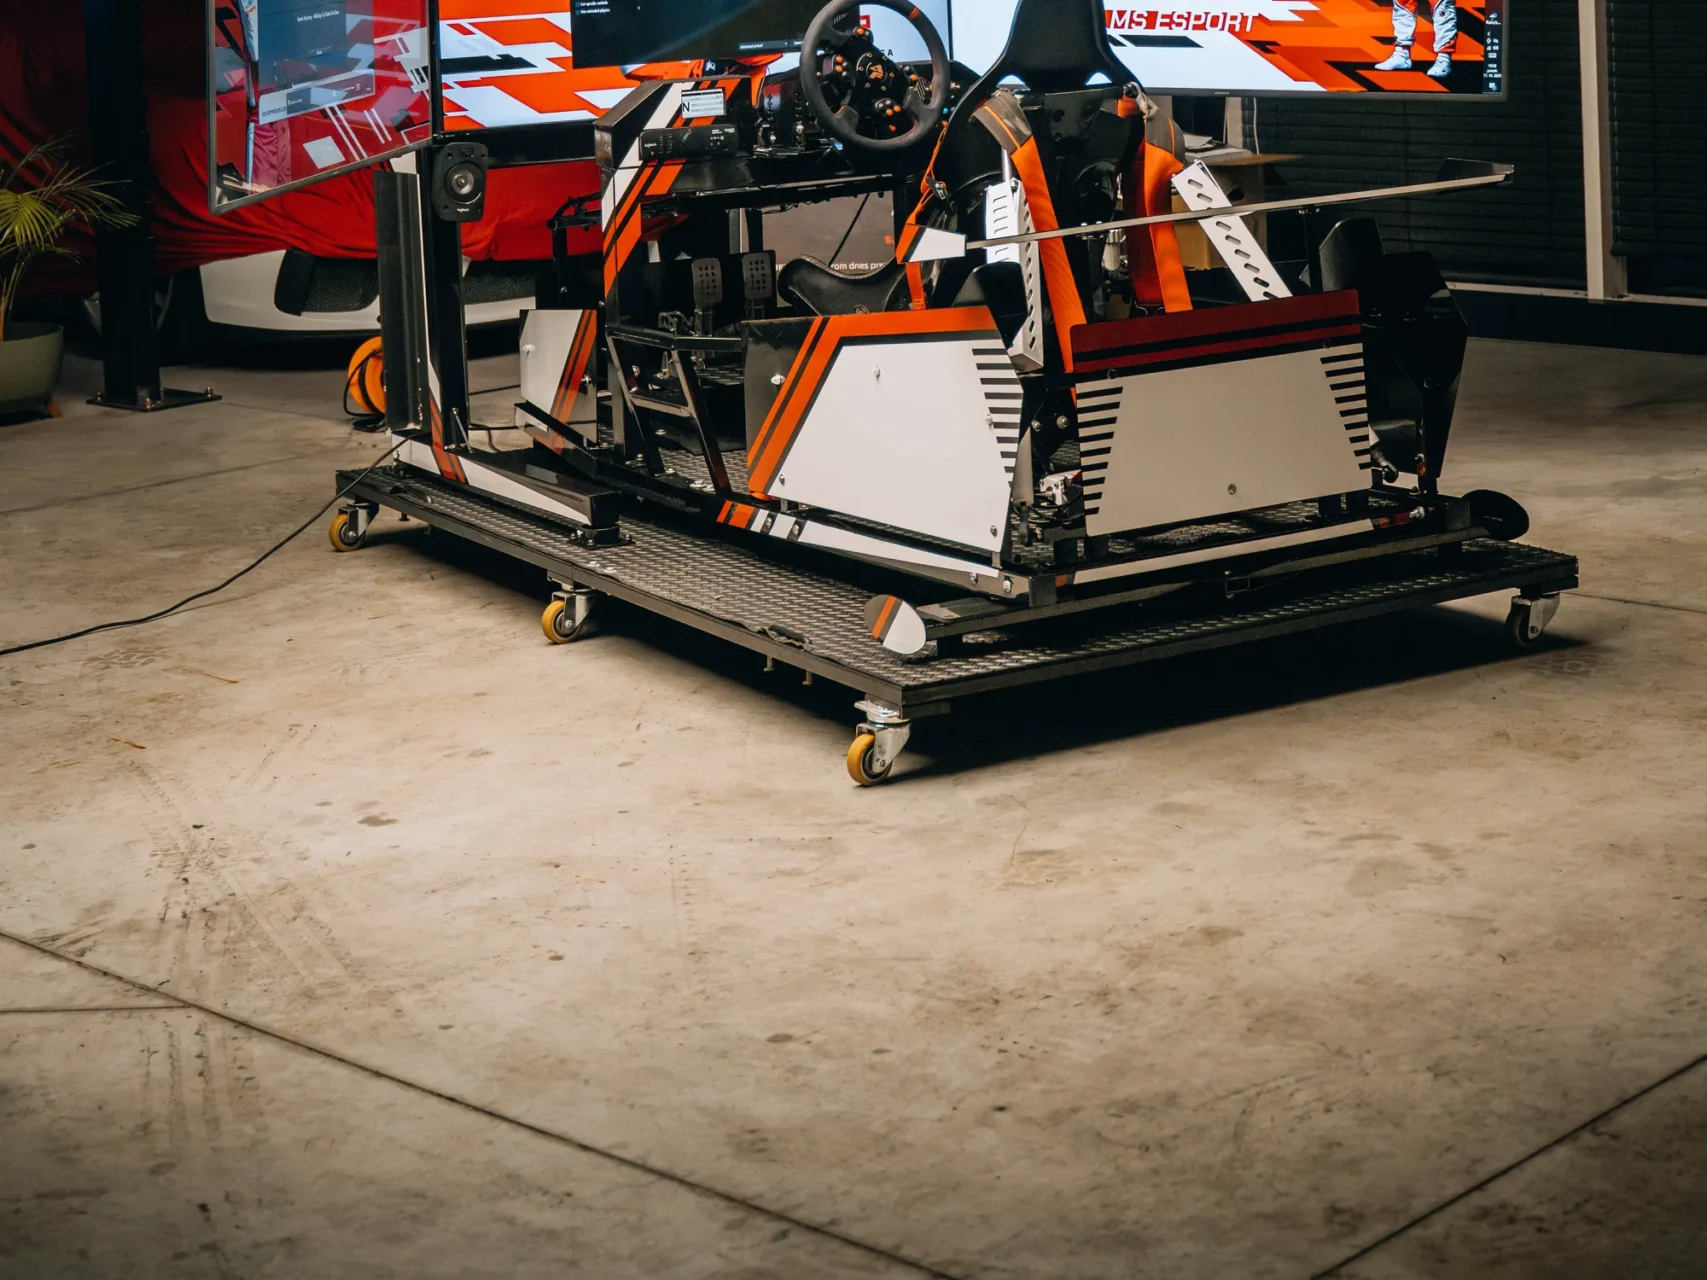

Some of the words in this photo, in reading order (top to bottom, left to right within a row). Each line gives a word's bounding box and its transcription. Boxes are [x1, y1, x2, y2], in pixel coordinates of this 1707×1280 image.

[1110, 10, 1149, 29] MS
[1155, 11, 1259, 32] ESPORT
[683, 101, 690, 112] N
[849, 261, 869, 270] dnes
[871, 263, 887, 272] pre
